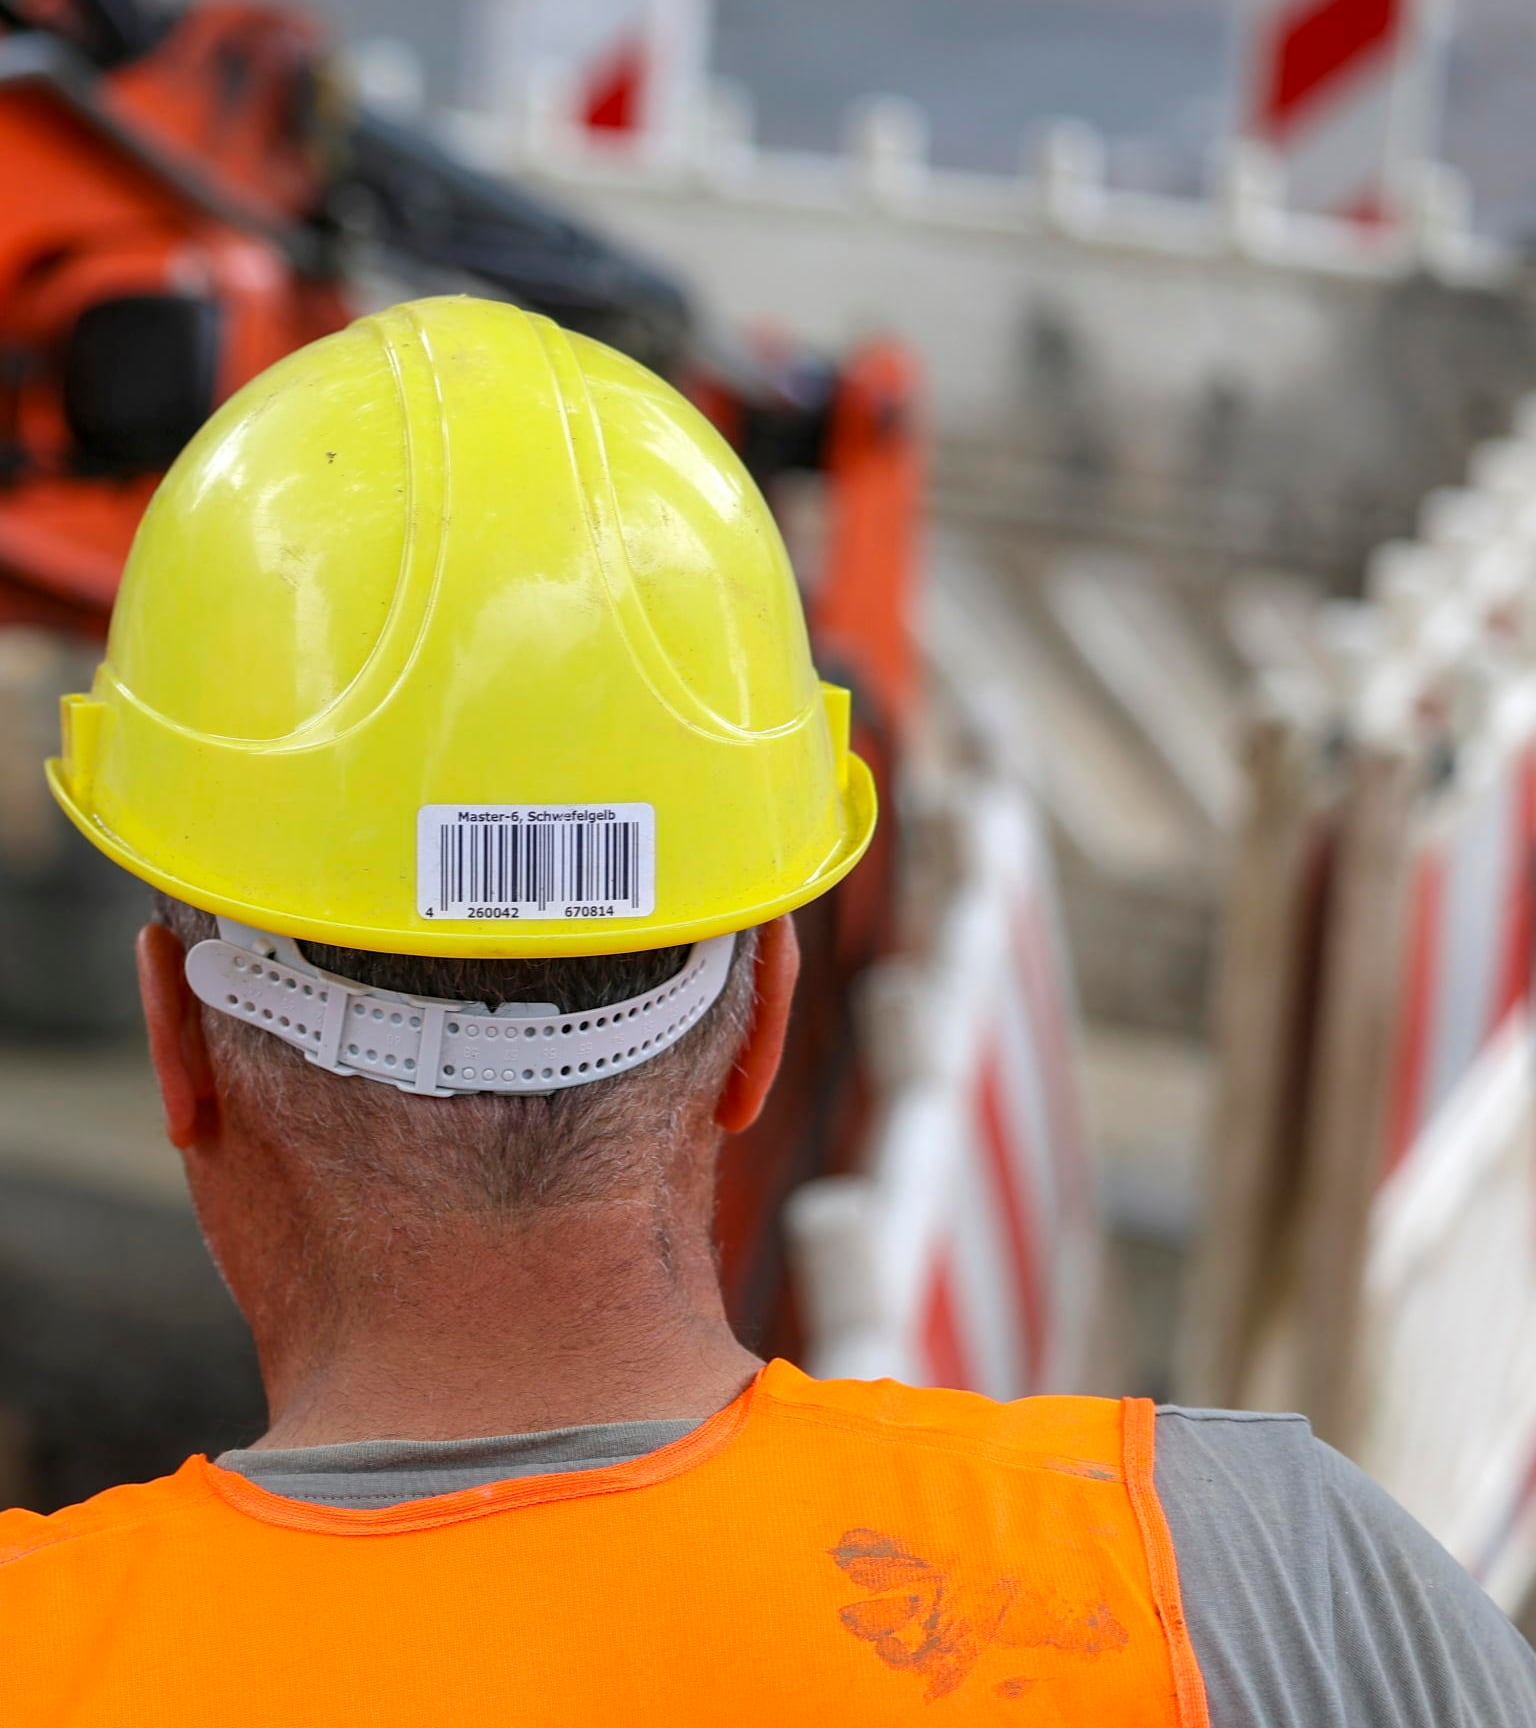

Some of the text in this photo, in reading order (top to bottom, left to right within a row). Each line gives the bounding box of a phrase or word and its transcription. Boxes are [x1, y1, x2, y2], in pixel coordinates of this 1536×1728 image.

[458, 809, 616, 824] Master-6, Schwefelgelb
[425, 906, 615, 918] 4 260042 670814
